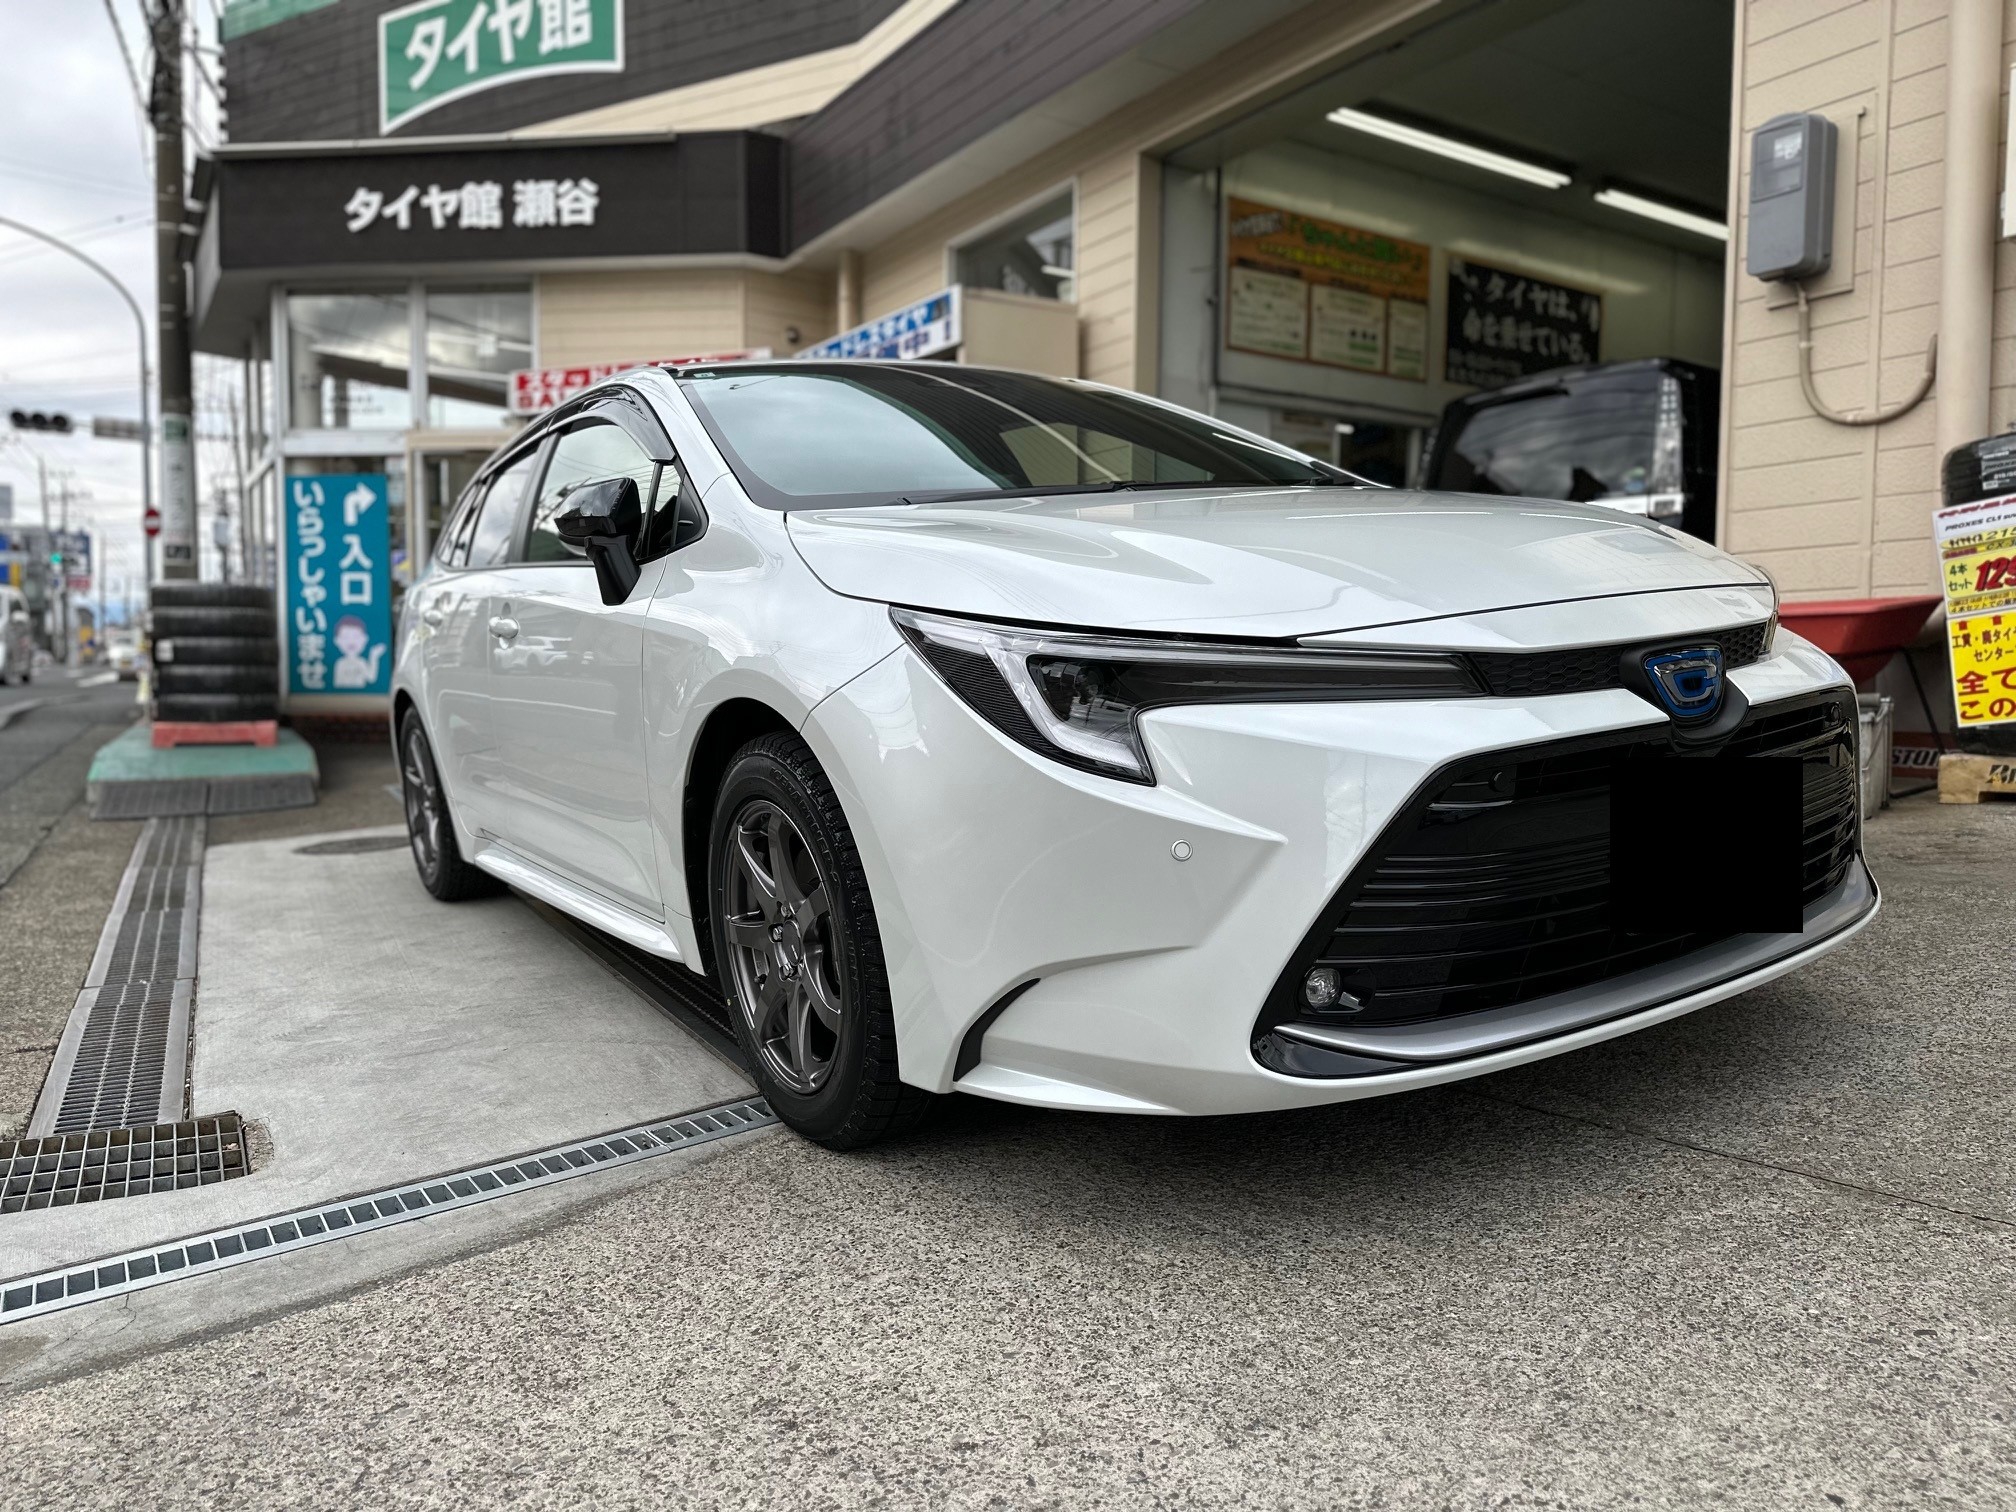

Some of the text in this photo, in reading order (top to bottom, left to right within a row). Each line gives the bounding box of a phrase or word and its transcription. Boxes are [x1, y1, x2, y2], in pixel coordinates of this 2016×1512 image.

[405, 0, 592, 91] タイヤ館
[344, 177, 600, 233] タイヤ館 瀬谷
[294, 480, 327, 689] いらっしゃいませ
[339, 534, 373, 606] 入口
[1950, 563, 1968, 576] 4本
[1948, 578, 1973, 592] セット
[1952, 626, 2016, 649] 工賃・廃タイ
[1956, 666, 2016, 696] 全て
[1960, 697, 2016, 720] この
